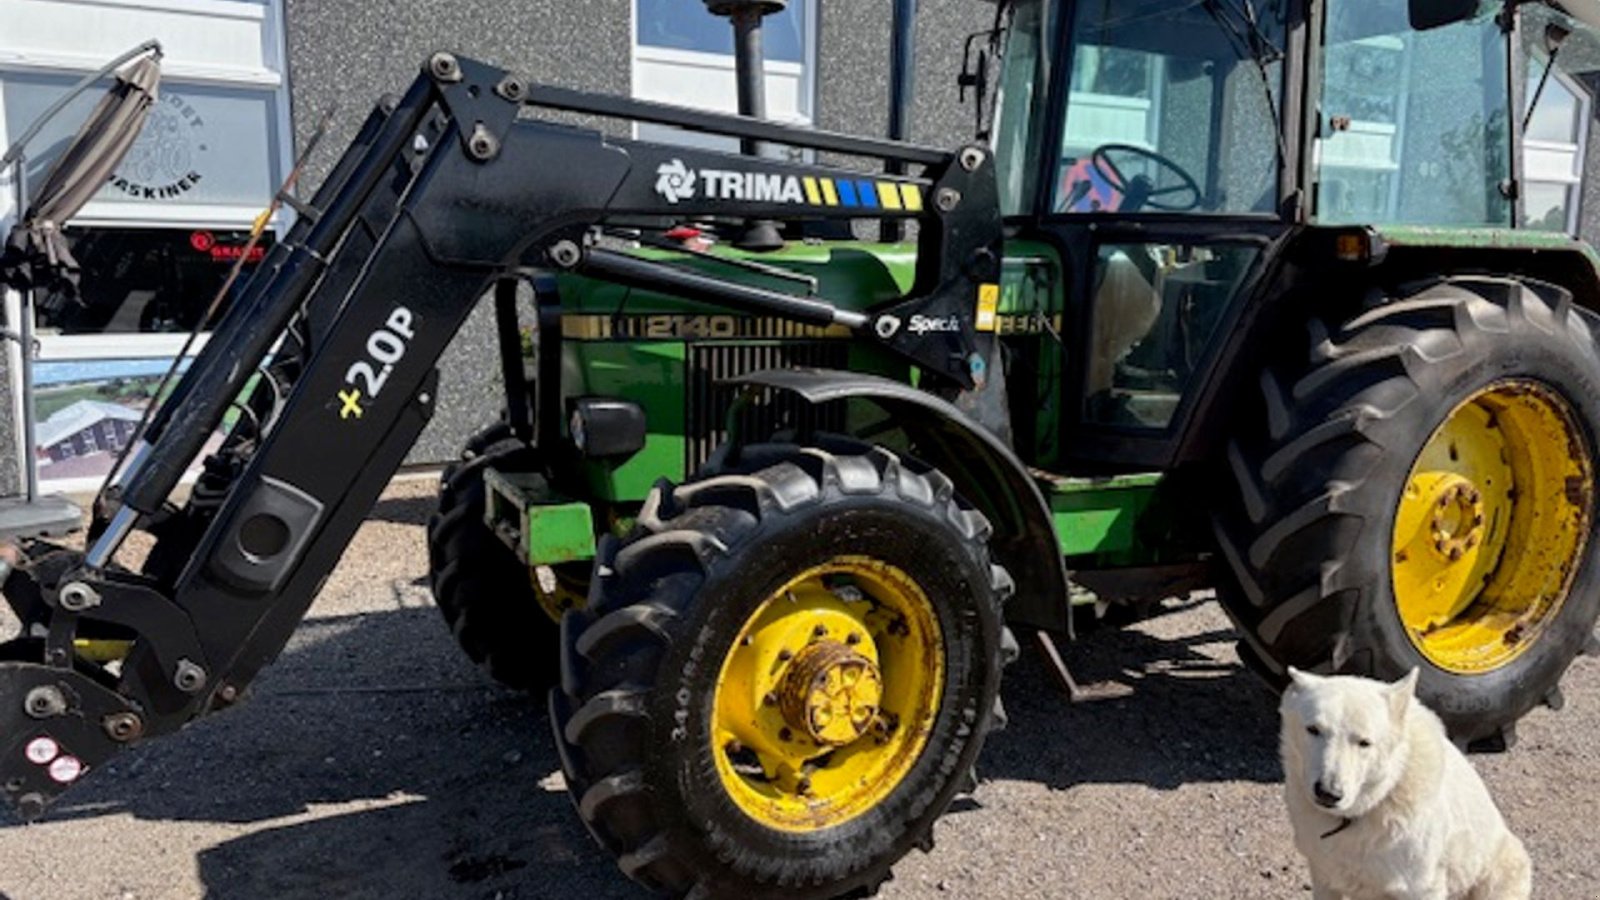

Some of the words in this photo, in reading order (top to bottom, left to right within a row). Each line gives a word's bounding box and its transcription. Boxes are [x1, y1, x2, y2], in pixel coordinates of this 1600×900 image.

[700, 169, 803, 203] TRIMA
[647, 315, 735, 338] 2140
[337, 306, 415, 419] +2.0P
